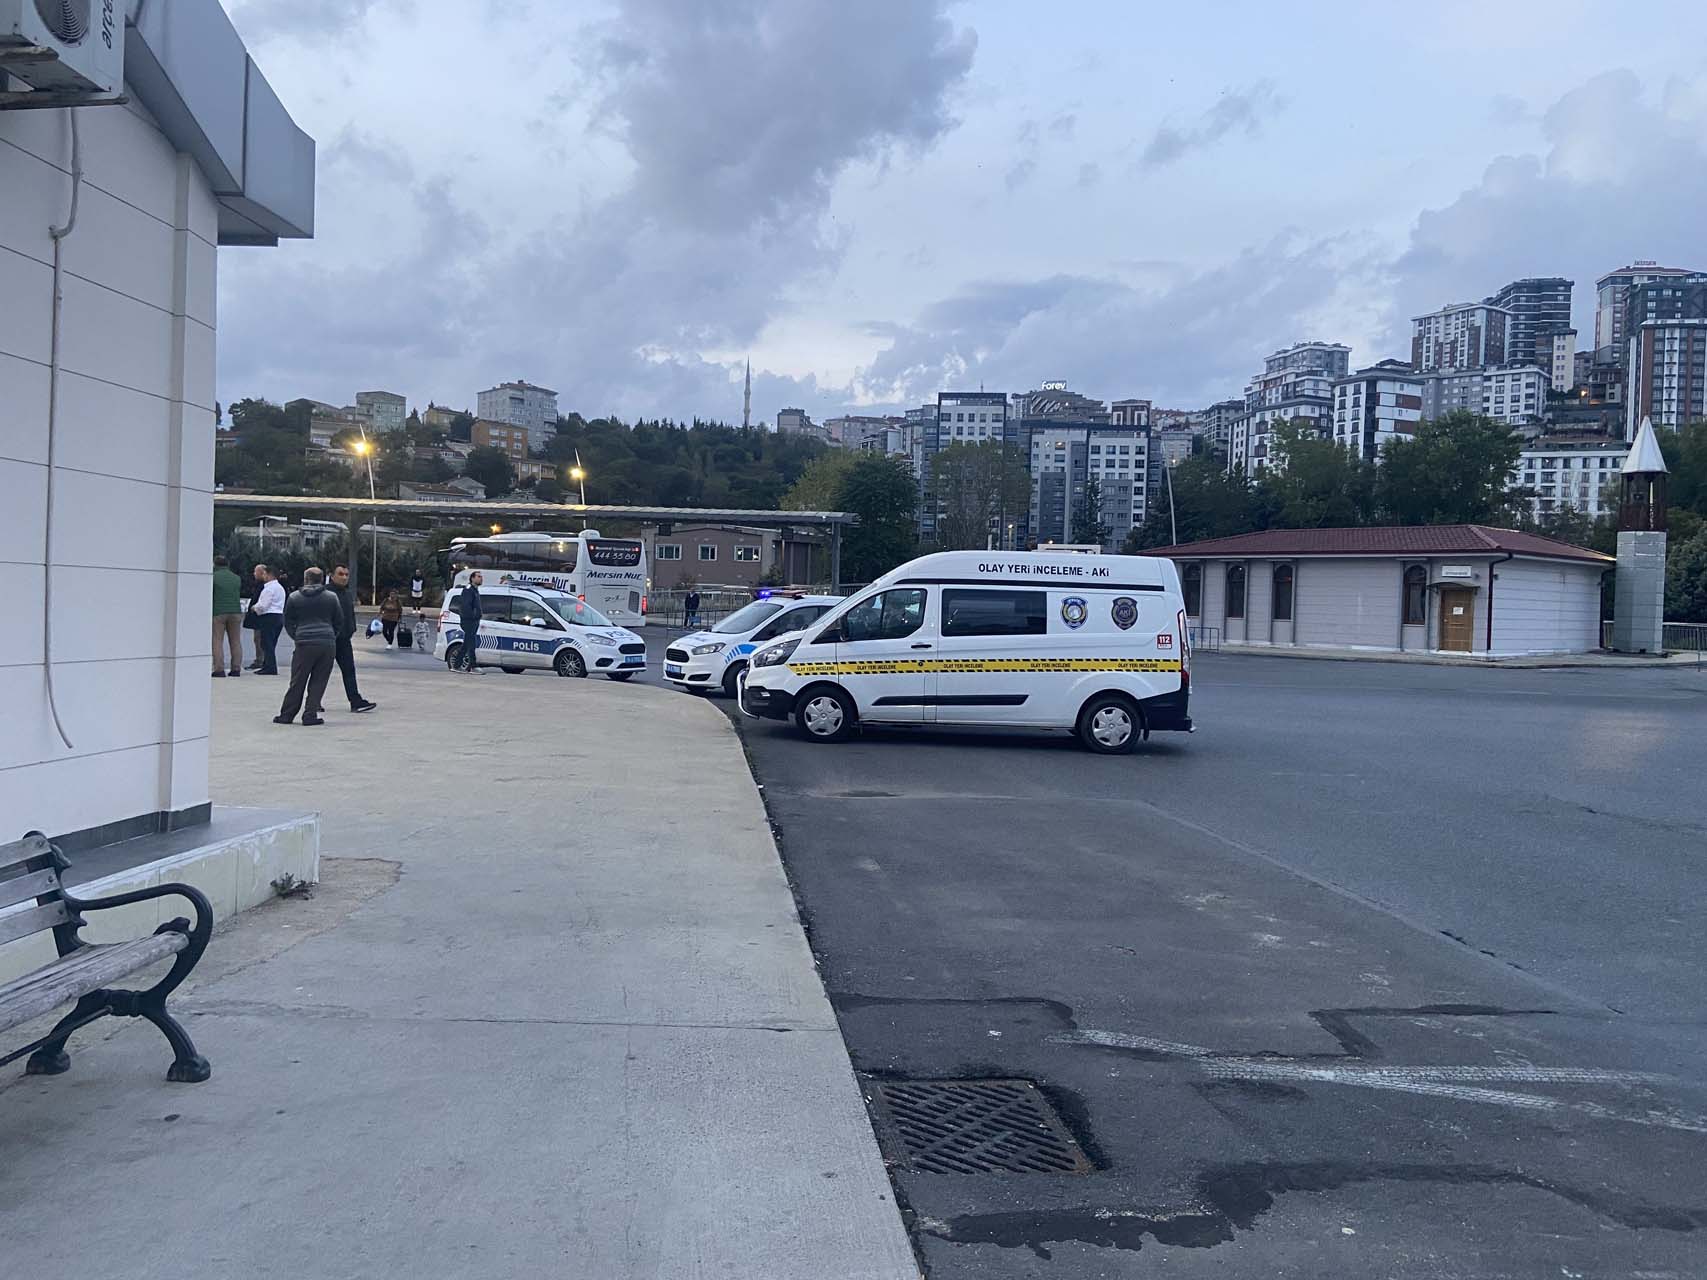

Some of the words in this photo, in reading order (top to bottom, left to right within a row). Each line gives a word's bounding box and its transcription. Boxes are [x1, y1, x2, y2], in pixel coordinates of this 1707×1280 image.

[102, 0, 115, 49] arçe
[978, 563, 1005, 573] OLAY
[586, 571, 623, 579] Mersin
[623, 572, 643, 580] Nur
